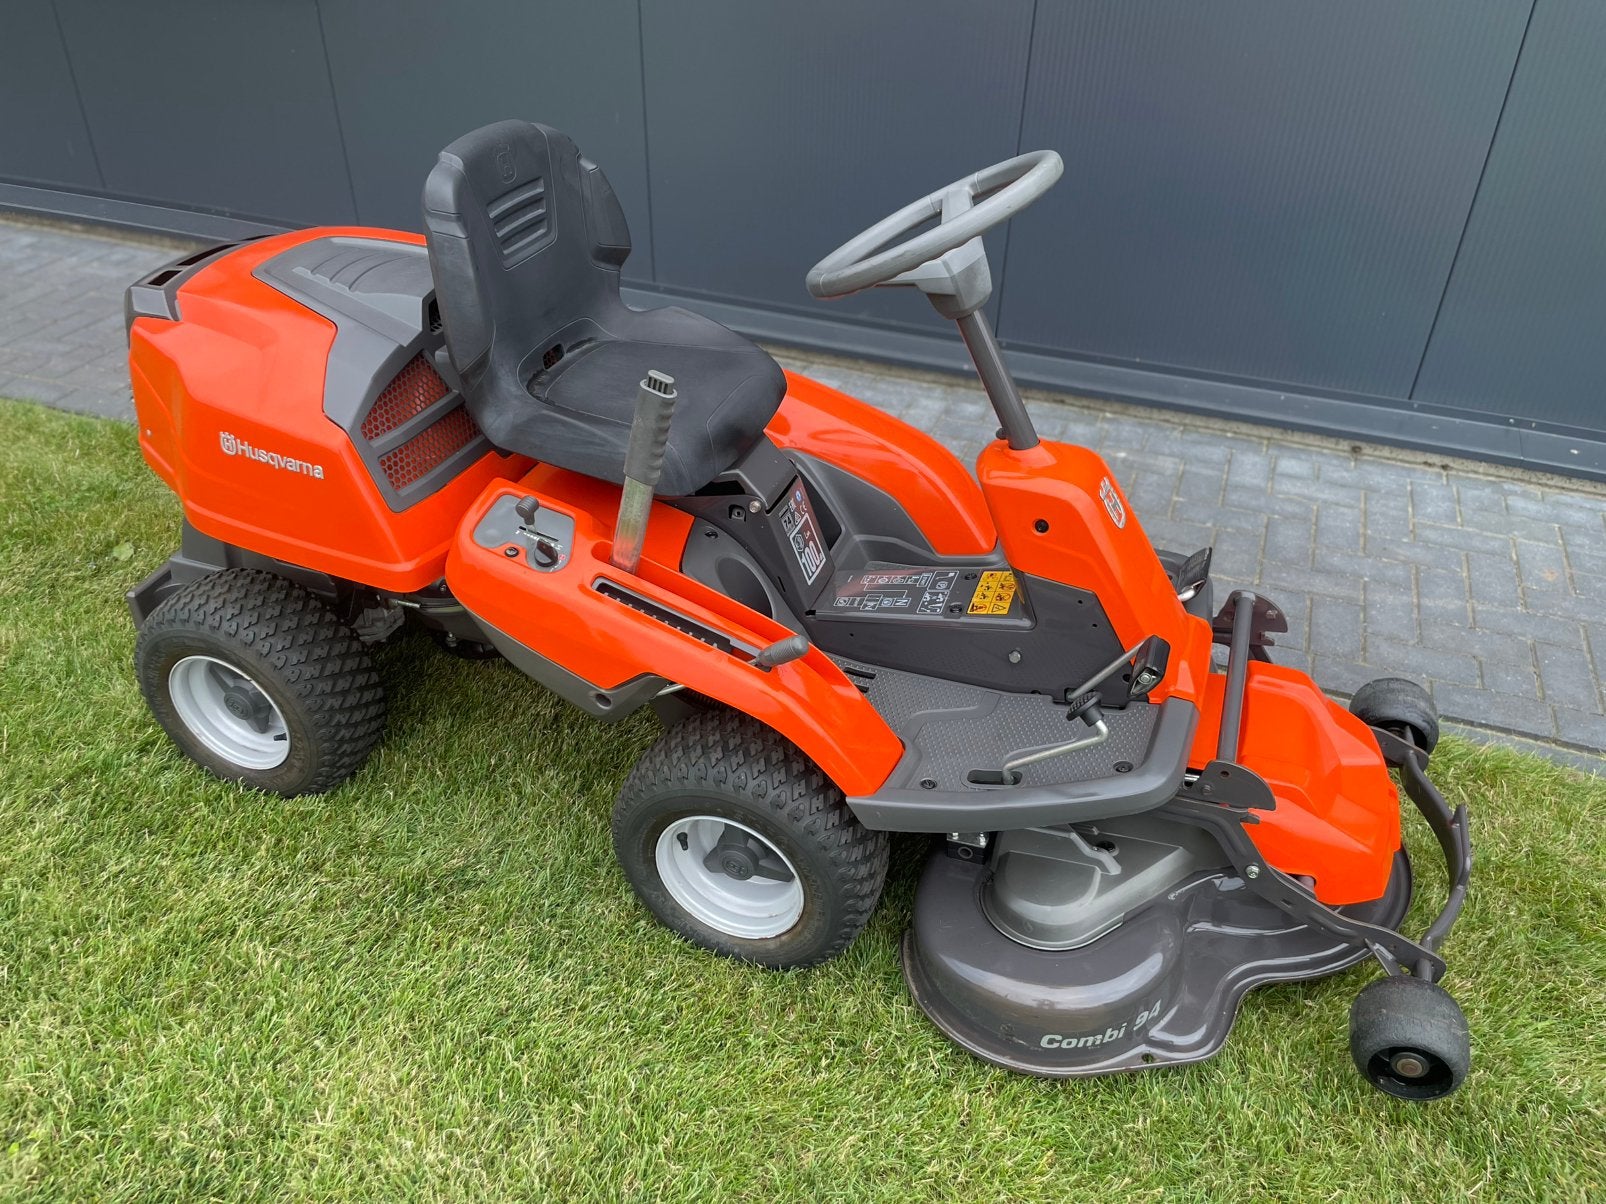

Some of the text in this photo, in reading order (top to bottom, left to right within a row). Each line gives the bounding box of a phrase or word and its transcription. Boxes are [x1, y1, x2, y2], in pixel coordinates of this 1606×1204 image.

[237, 438, 325, 480] Husqvarna
[783, 516, 792, 529] 74
[801, 540, 821, 577] 100
[1040, 999, 1162, 1050] Combi 94
